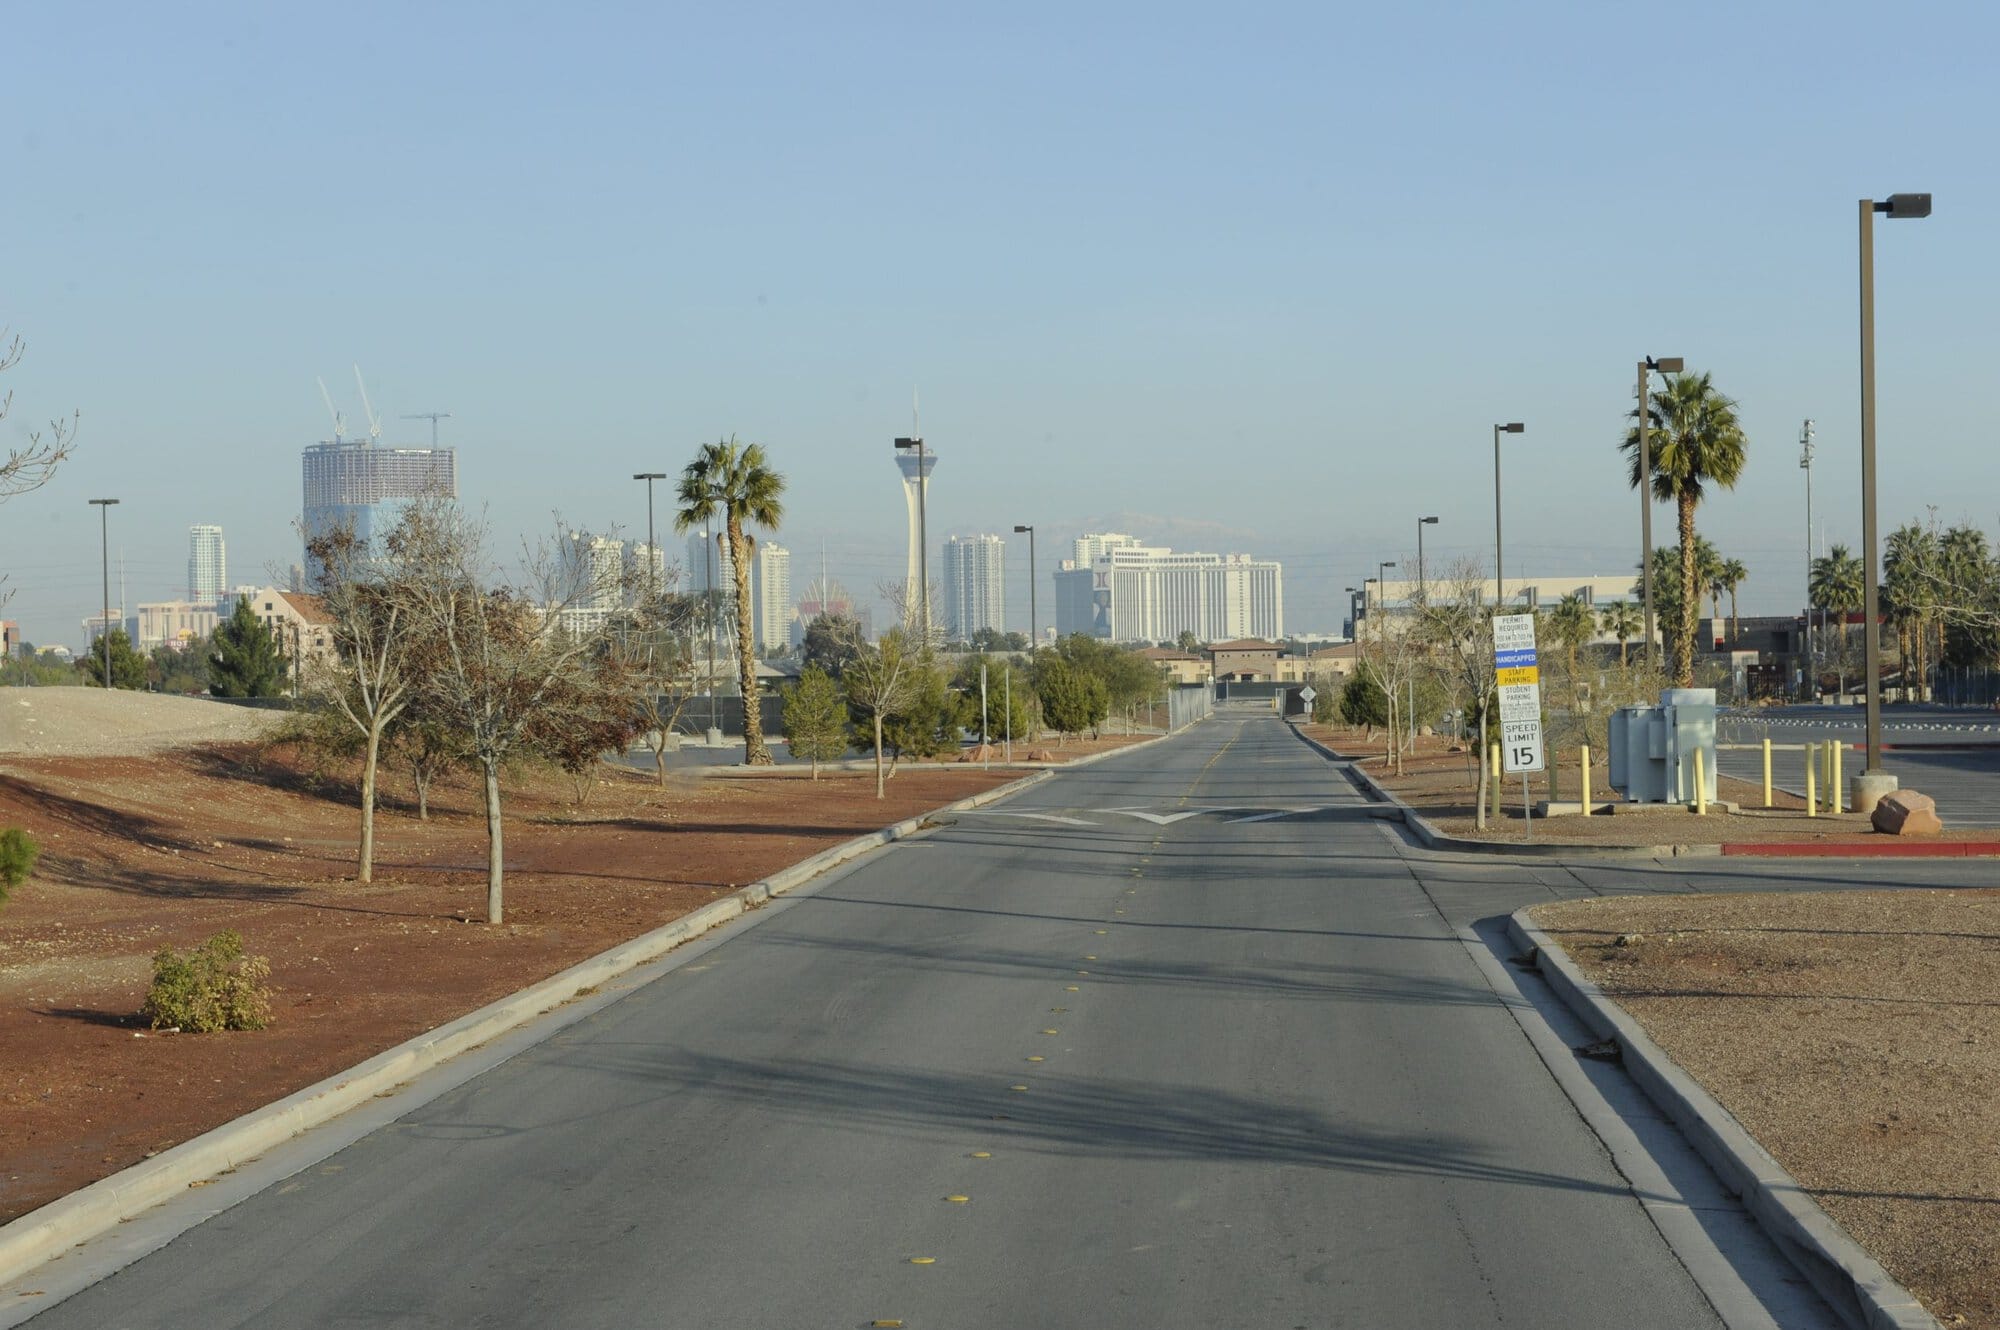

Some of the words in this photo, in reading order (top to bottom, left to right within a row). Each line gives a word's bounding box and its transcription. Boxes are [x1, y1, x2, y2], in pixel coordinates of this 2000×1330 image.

[1502, 616, 1524, 624] PERMIT
[1499, 624, 1529, 632] REQUIRED
[1496, 654, 1536, 664] HANDICAPPED
[1504, 676, 1531, 684] PARKING
[1505, 686, 1531, 694] STUDENT
[1506, 693, 1531, 701] PARKING
[1505, 723, 1537, 733] SPEED
[1508, 733, 1535, 742] LIMIT
[1512, 747, 1534, 766] 15
